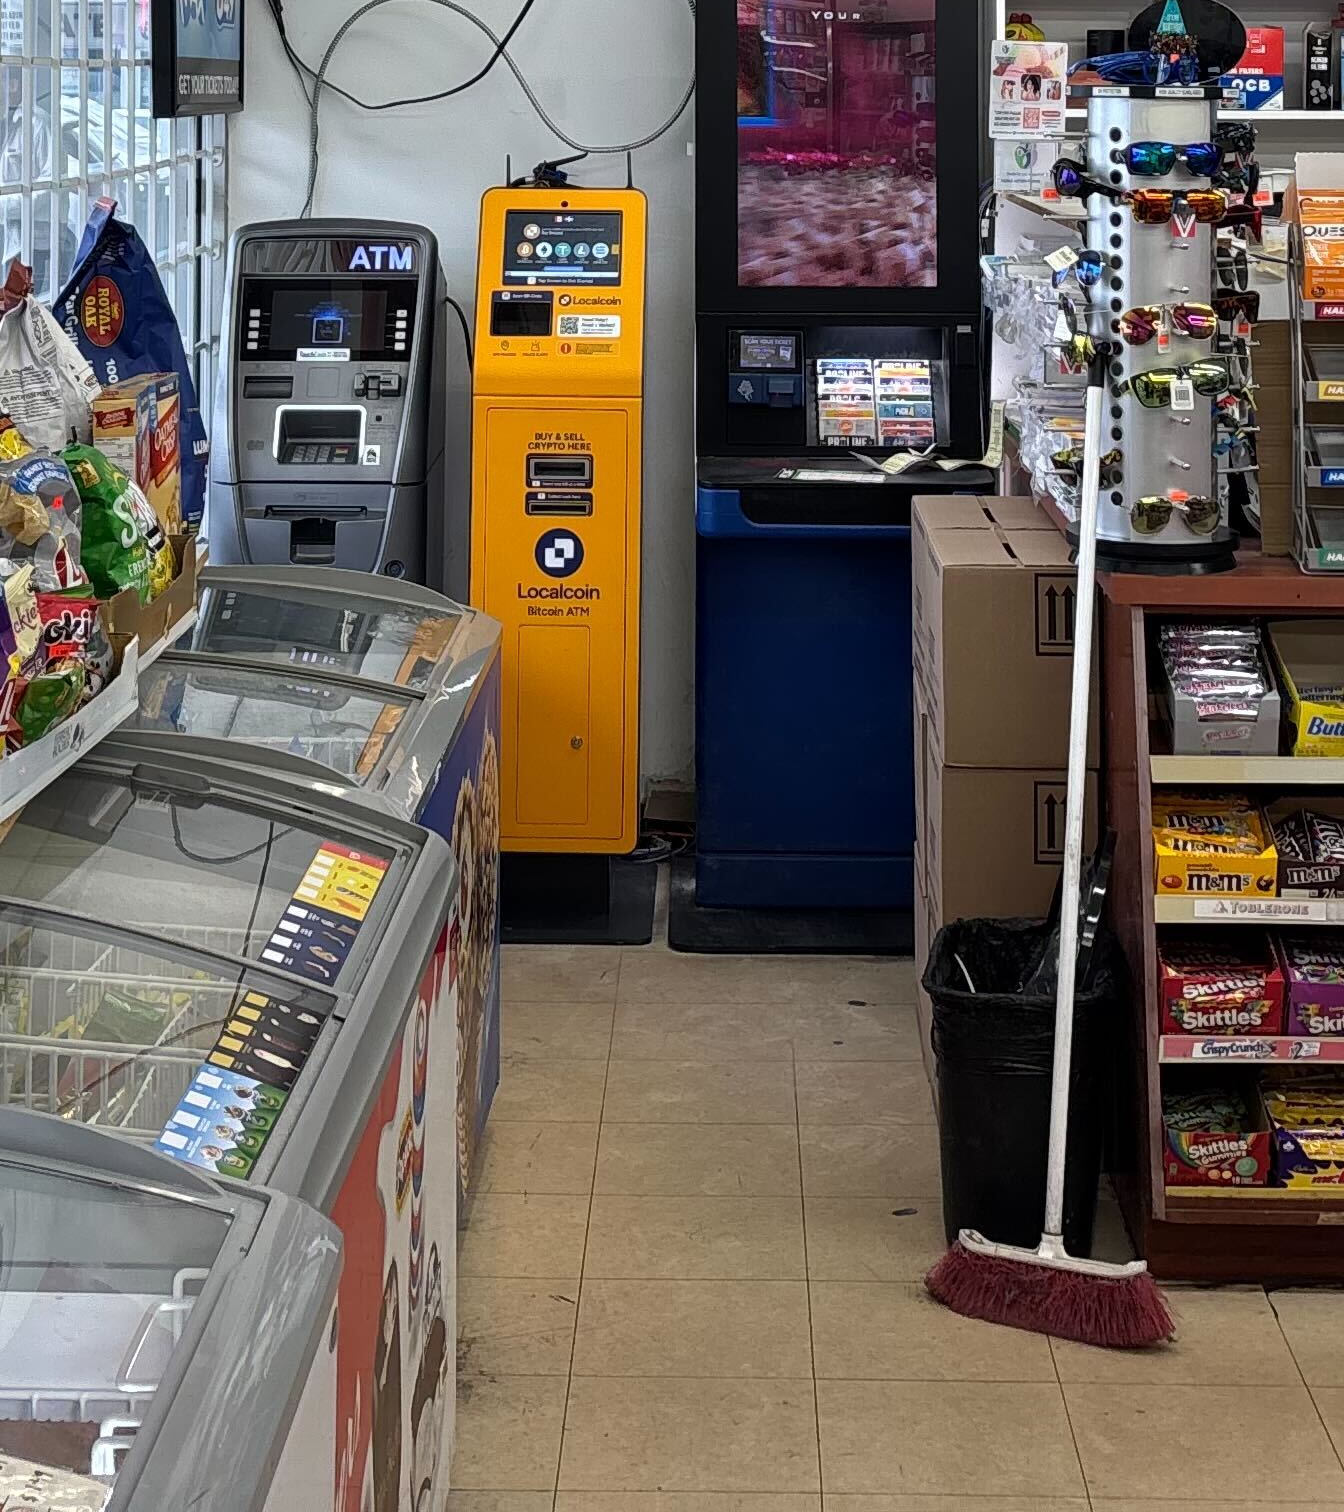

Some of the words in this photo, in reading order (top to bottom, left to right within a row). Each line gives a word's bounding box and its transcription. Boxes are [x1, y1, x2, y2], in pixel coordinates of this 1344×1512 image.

[811, 11, 860, 20] YOUR
[179, 75, 190, 95] GET
[191, 75, 205, 95] YOUR
[1232, 79, 1270, 91] OCB
[348, 246, 413, 270] ATM
[573, 296, 621, 306] Localcoin
[84, 296, 98, 328] OAK
[98, 287, 111, 336] ROYAL
[104, 358, 119, 383] 100
[535, 433, 553, 441] BUY
[555, 433, 562, 441] &
[564, 433, 585, 441] SELL
[528, 442, 565, 450] CRYPTO
[568, 442, 592, 450] HERE
[517, 583, 600, 600] Localcoin
[527, 606, 563, 616] Bitcoin
[566, 607, 590, 616] ATM
[1186, 872, 1252, 892] m&m's
[1286, 866, 1341, 885] m&m's
[1229, 900, 1310, 916] TOBLERONE
[1182, 1010, 1263, 1031] Skittles
[1189, 1140, 1248, 1157] Skittles
[1201, 1150, 1248, 1166] Gummies
